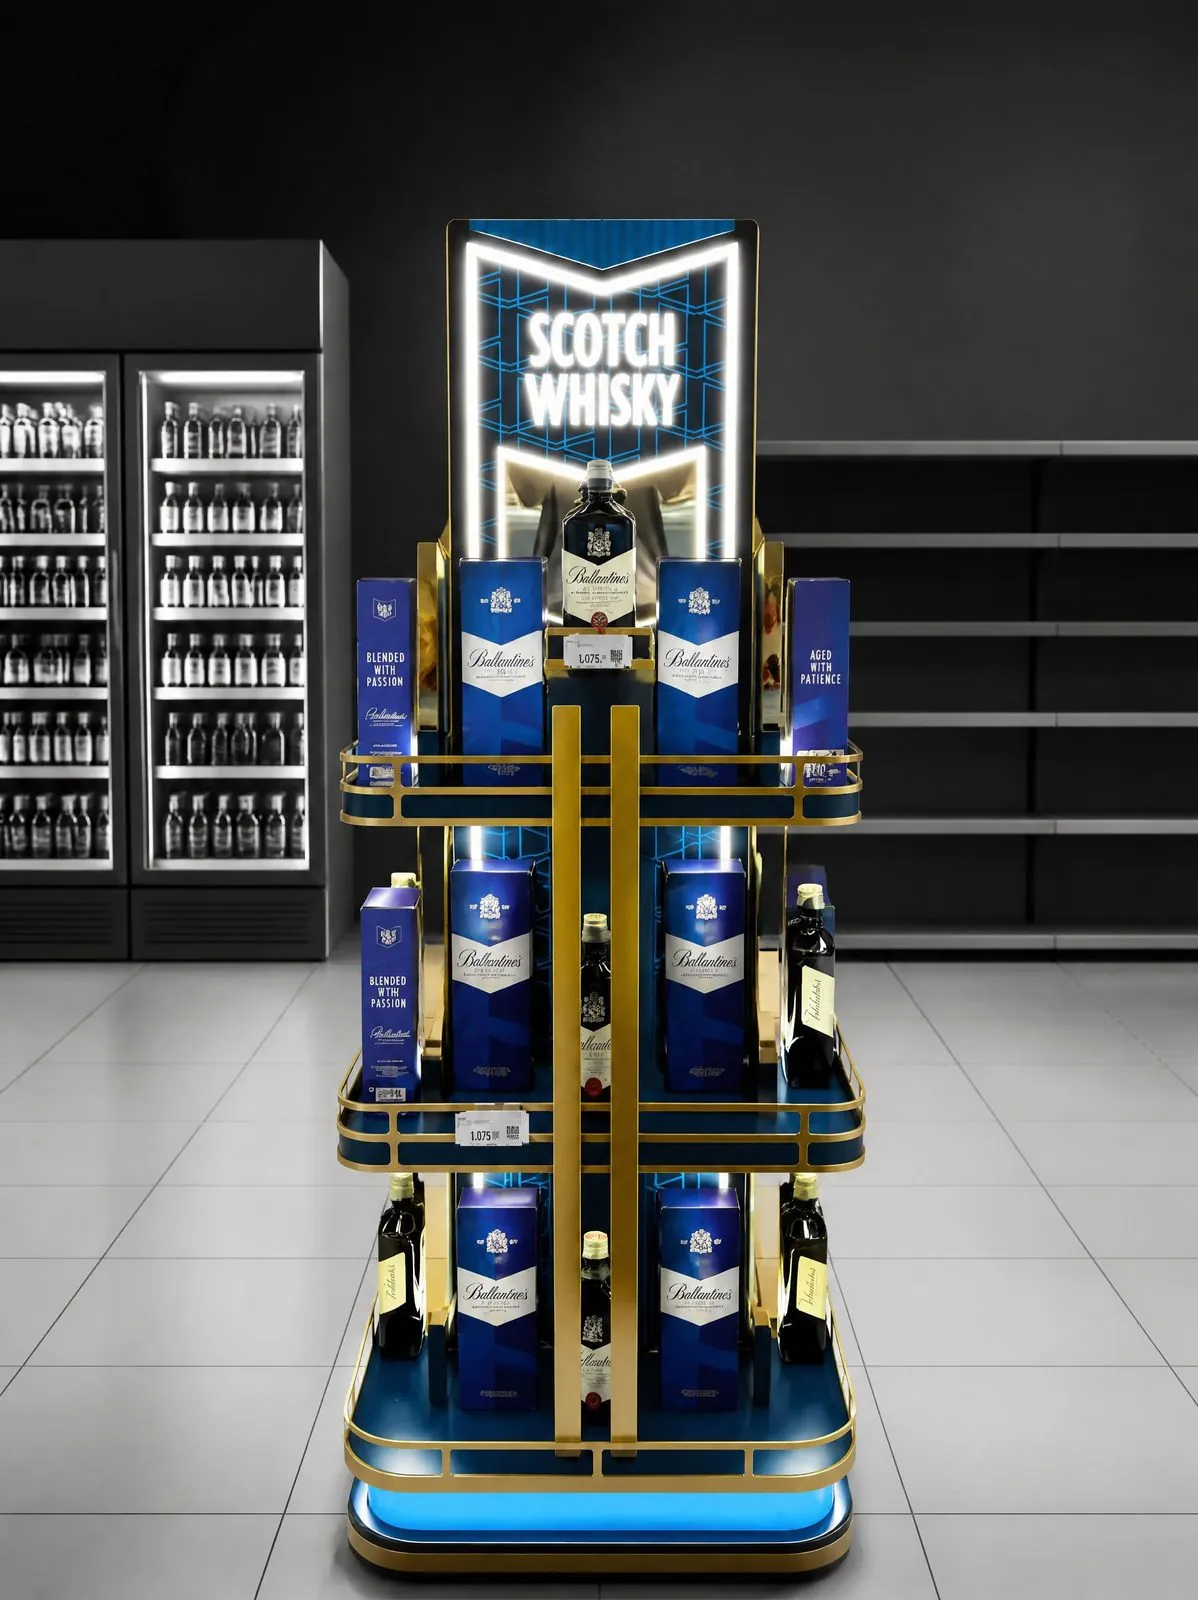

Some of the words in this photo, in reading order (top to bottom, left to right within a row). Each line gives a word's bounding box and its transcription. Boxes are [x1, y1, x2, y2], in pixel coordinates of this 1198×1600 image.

[529, 312, 676, 368] SCOTCH
[524, 373, 681, 427] WHISKY
[566, 566, 631, 584] Ballantine's
[366, 652, 405, 663] BLENDED
[663, 648, 732, 669] Ballantine's
[809, 649, 832, 661] AGED
[374, 664, 396, 675] WITH
[810, 662, 832, 672] WITH
[366, 676, 404, 687] PASSION
[800, 673, 841, 685] PATIENCE
[369, 976, 407, 986] BLENDED
[371, 998, 407, 1008] PASSION
